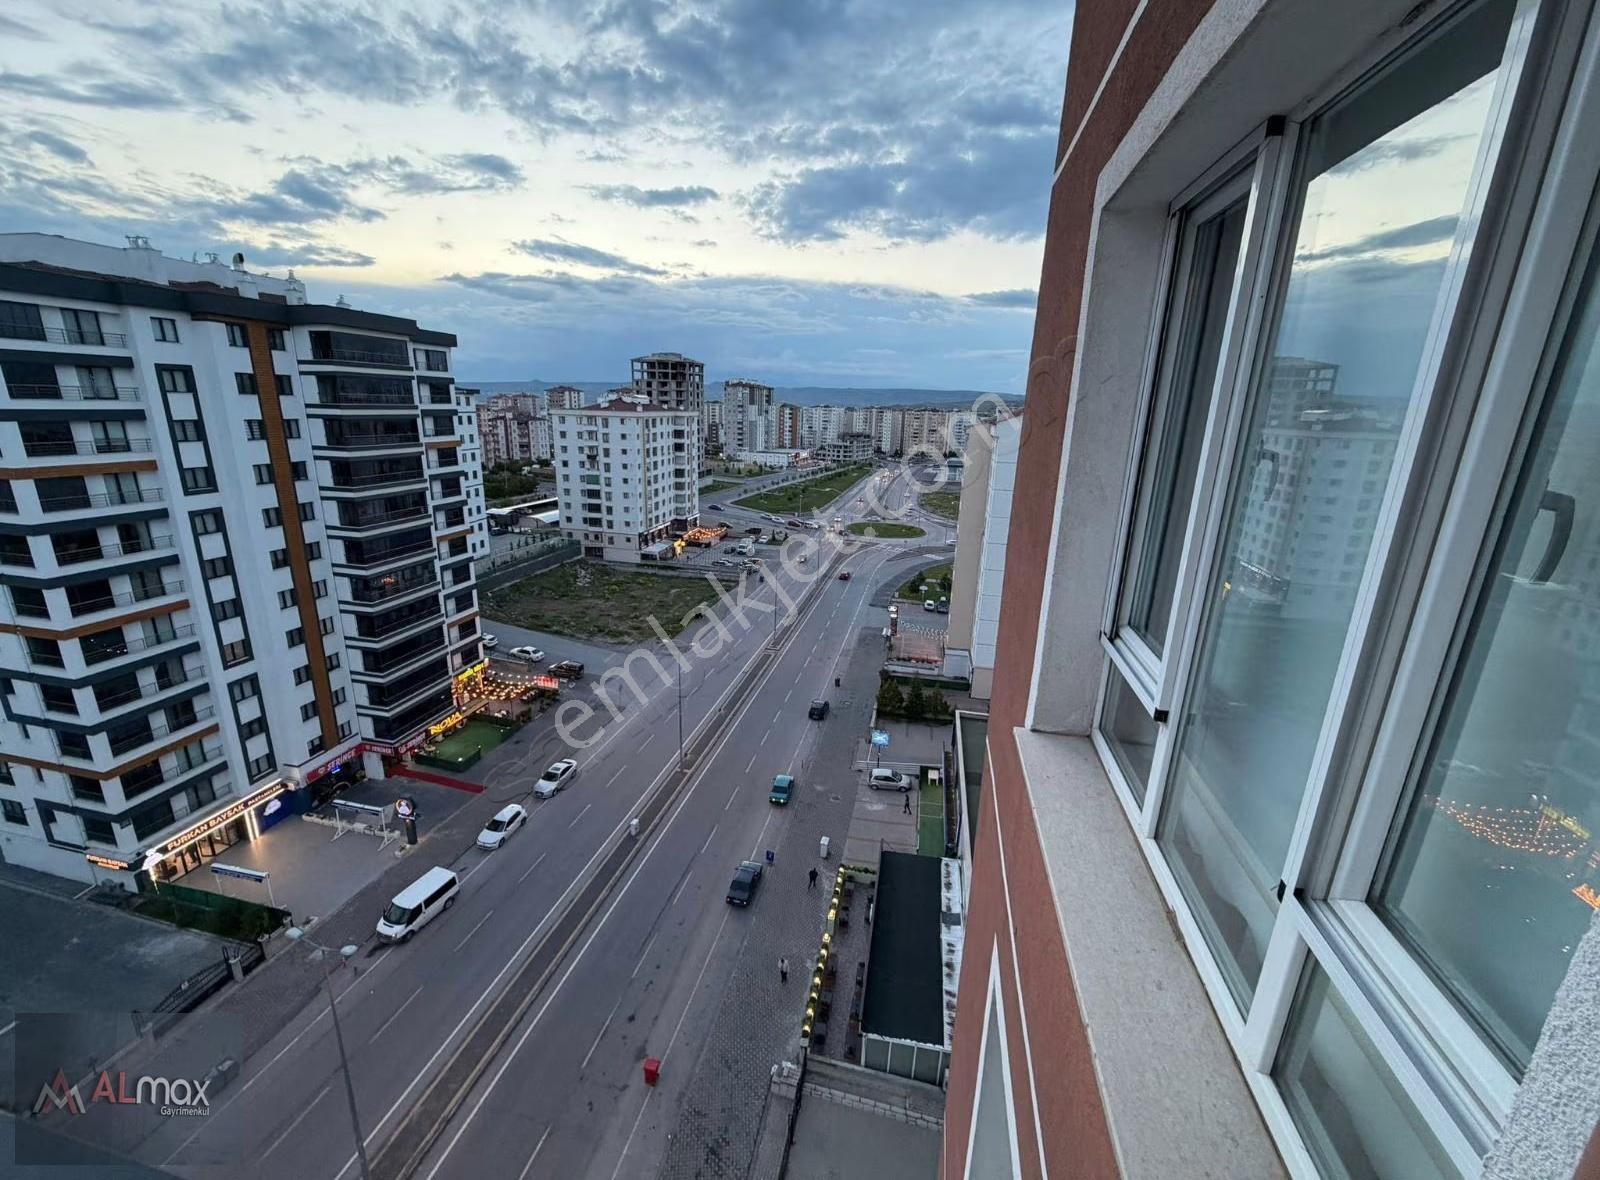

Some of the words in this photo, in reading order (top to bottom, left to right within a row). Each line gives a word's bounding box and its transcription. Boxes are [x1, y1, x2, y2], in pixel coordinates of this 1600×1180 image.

[428, 712, 463, 735] NOVA
[167, 824, 208, 851] FURKAN
[208, 803, 245, 828] BAYSAK
